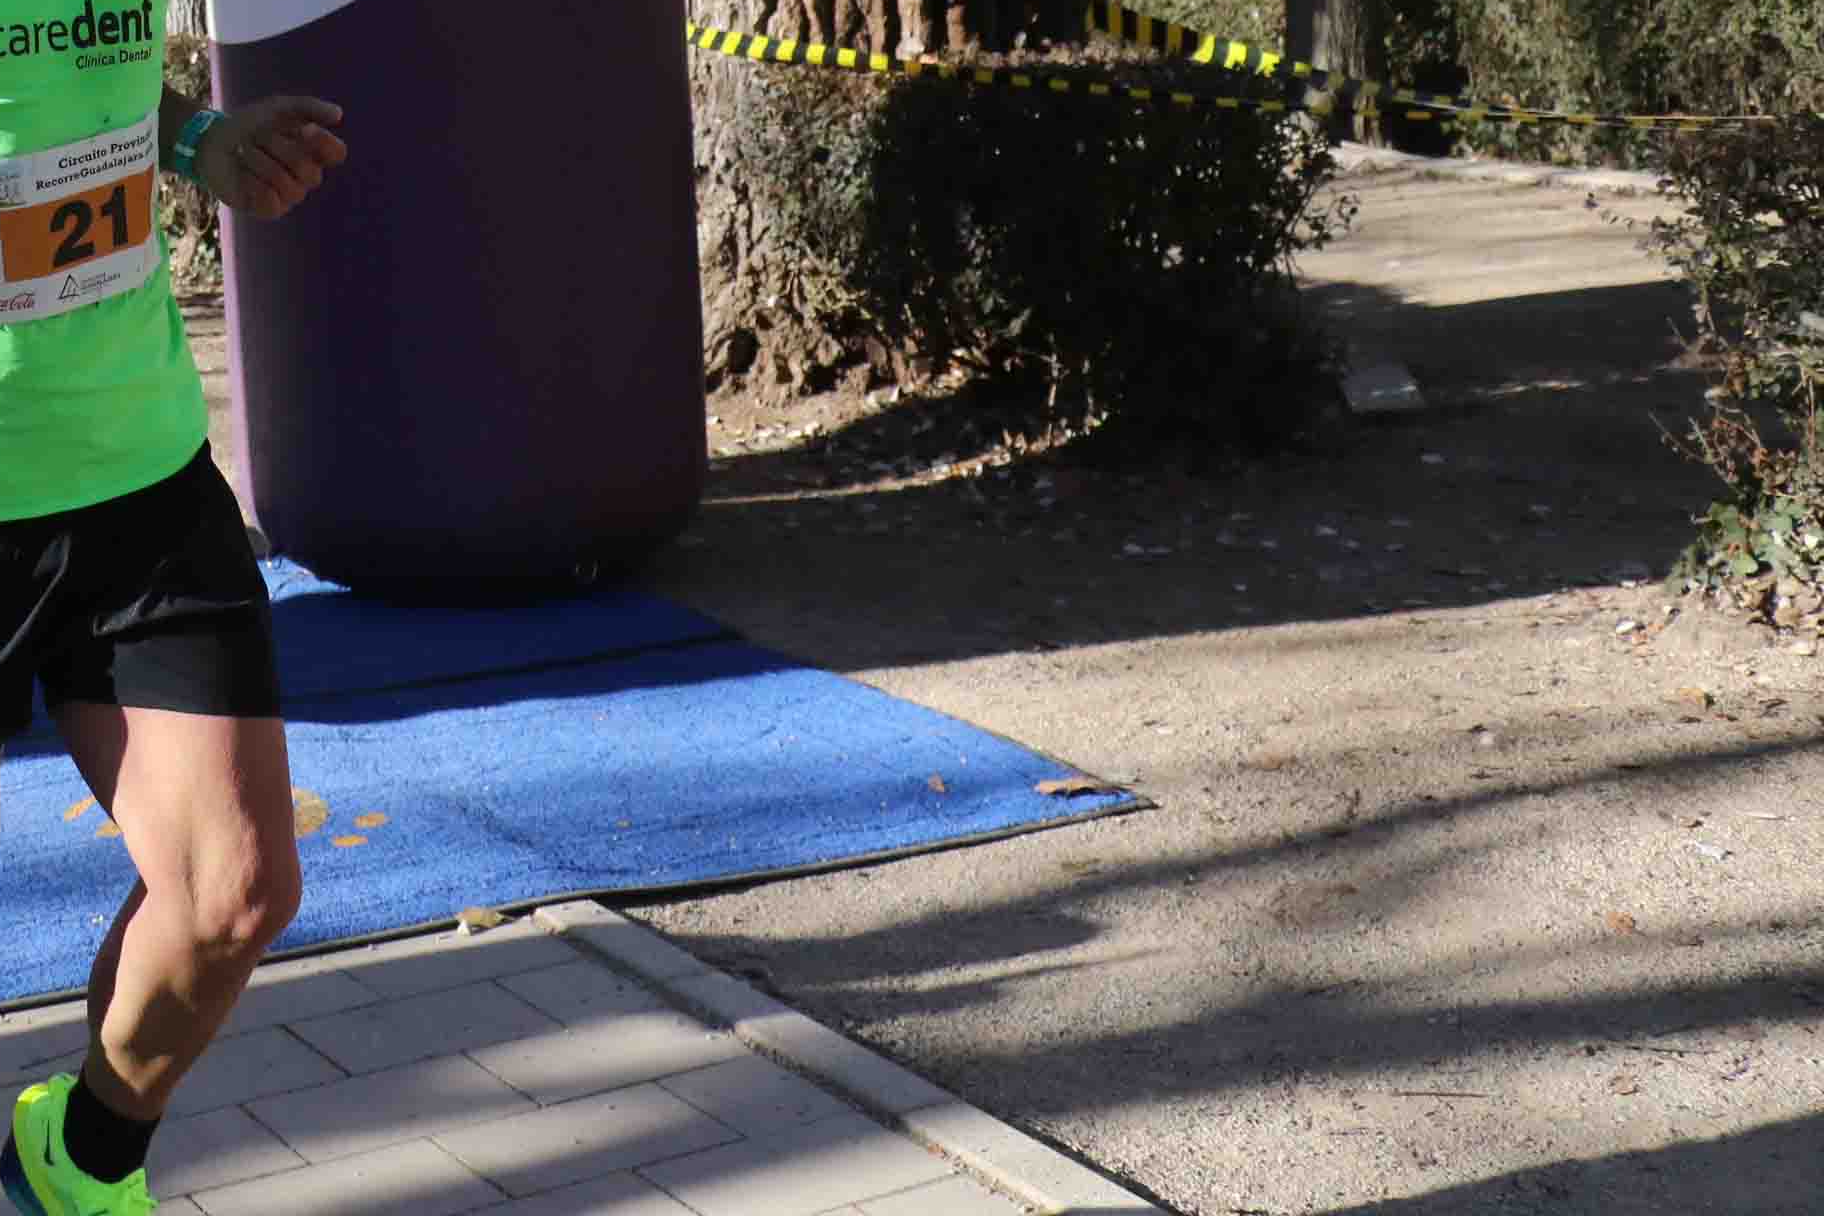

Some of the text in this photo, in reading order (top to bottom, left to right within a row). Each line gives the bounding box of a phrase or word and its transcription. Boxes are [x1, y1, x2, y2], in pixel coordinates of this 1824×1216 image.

[119, 48, 152, 64] Dental
[58, 148, 107, 169] Circuito
[49, 186, 129, 267] 21
